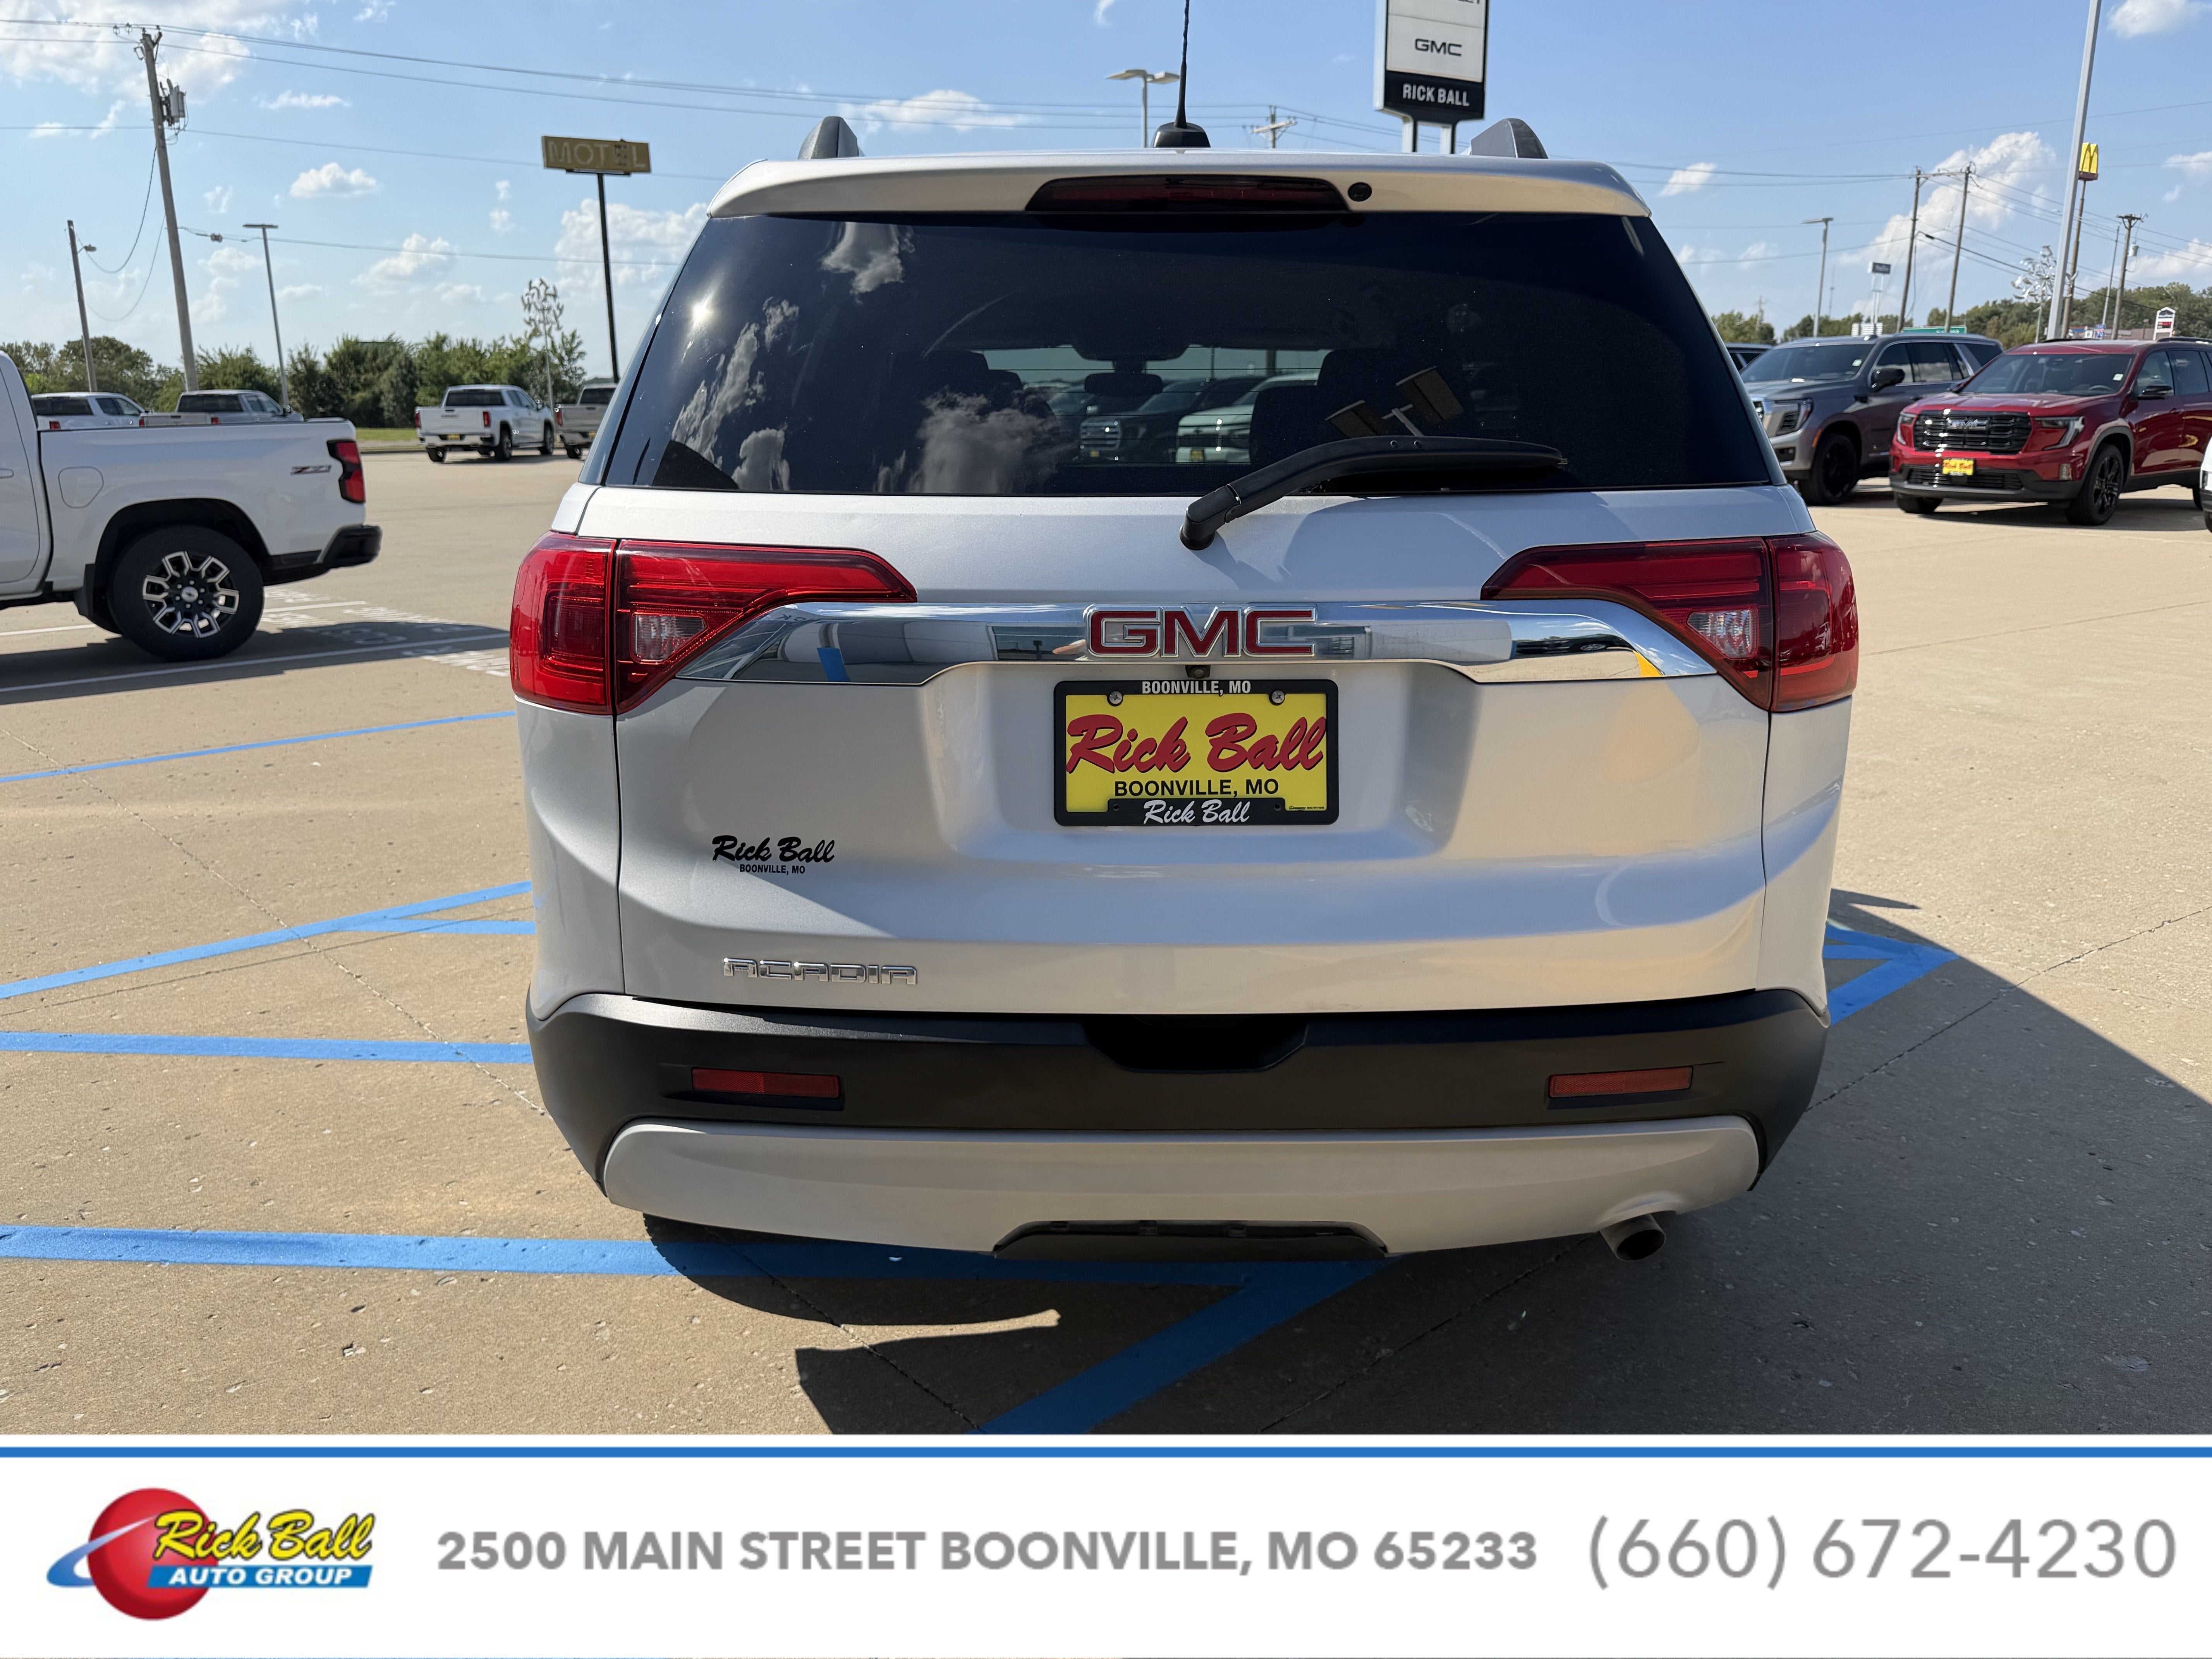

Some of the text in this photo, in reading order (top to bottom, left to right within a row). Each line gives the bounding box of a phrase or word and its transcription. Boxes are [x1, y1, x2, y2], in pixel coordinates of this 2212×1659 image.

[1415, 38, 1462, 57] GMC
[1402, 82, 1470, 106] RICK BALL
[1084, 603, 1316, 658] GMC
[1142, 680, 1251, 696] BOONVILLE, MO
[1066, 713, 1327, 774] Rick Ball
[1115, 778, 1279, 799] BOONVILLE, MO
[1144, 799, 1250, 824] Rick Ball
[712, 835, 835, 863] Rick Ball
[739, 864, 805, 875] BOONVILLE, MO
[723, 958, 917, 985] ACADIA
